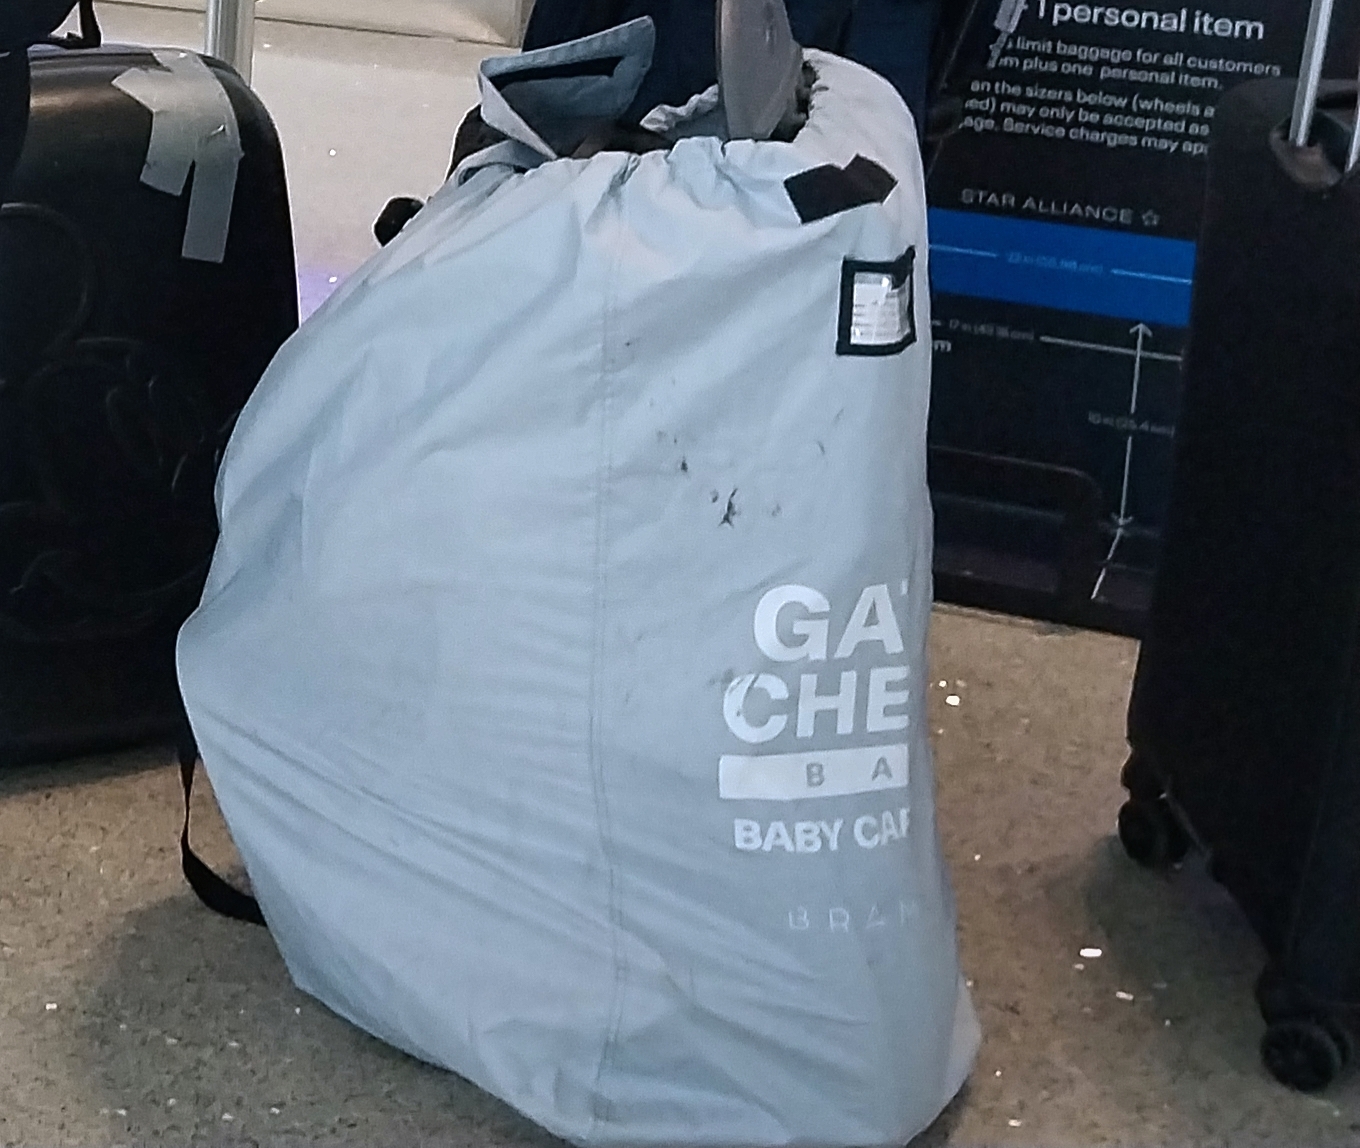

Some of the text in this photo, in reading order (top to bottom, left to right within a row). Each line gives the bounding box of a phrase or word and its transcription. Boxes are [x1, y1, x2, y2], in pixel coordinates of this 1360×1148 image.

[1053, 0, 1187, 32] personal
[1193, 9, 1265, 41] item
[1017, 35, 1281, 77] limit baggage for all customers
[1023, 55, 1058, 72] plus
[1061, 61, 1094, 77] one
[1099, 65, 1176, 85] personal
[994, 80, 1022, 97] the
[1025, 84, 1074, 102] sizers
[1076, 88, 1128, 109] below
[1132, 92, 1200, 118] (wheels
[1000, 101, 1036, 118] may
[1038, 105, 1076, 123] only
[1078, 107, 1100, 124] be
[1102, 112, 1186, 133] accepted
[1188, 121, 1210, 137] as
[1003, 117, 1066, 139] Service
[1068, 126, 1138, 149] charges
[1141, 135, 1180, 154] may
[960, 187, 1134, 226] STAR ALLIANCE
[754, 577, 909, 663] GA
[734, 818, 844, 853] BABY
